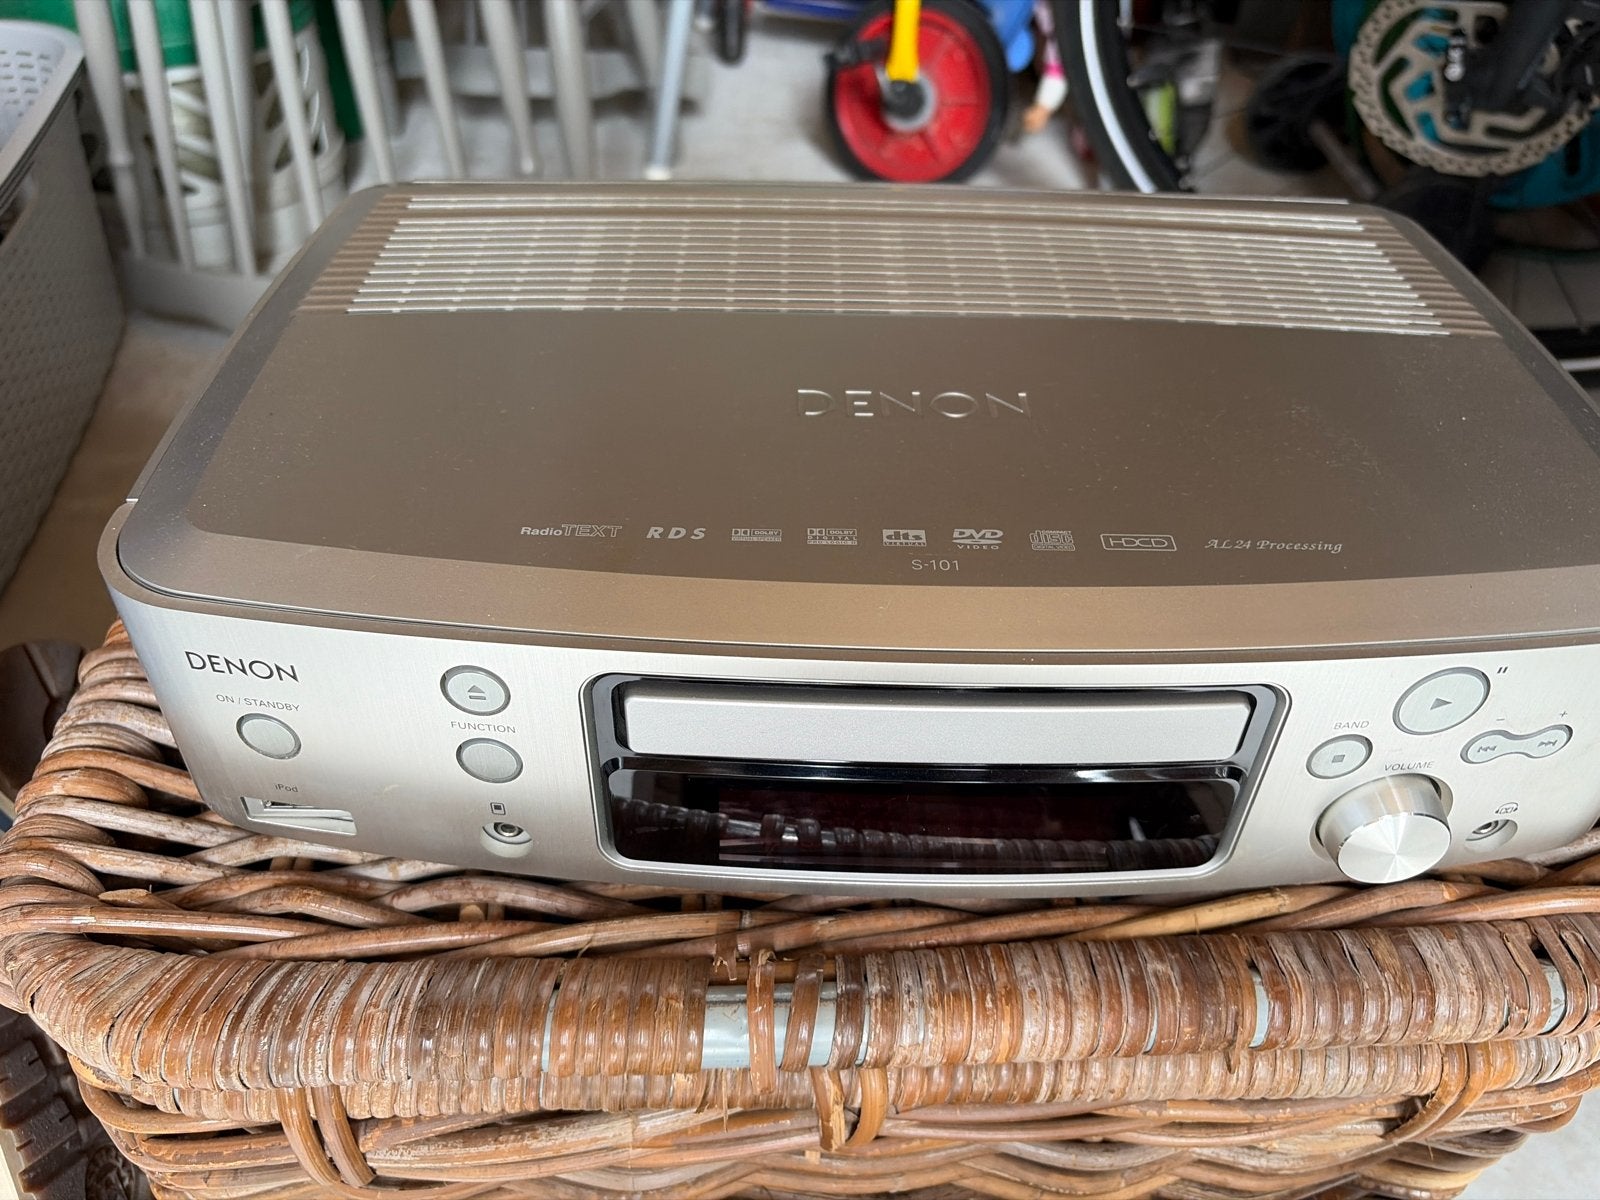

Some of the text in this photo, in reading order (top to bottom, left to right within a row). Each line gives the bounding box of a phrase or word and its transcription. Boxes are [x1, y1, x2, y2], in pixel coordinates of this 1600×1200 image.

[797, 389, 1031, 418] DENON
[646, 526, 707, 540] RDS
[953, 528, 1004, 540] DVD
[1109, 537, 1169, 548] HDCD
[1256, 539, 1343, 554] Processing
[911, 559, 960, 571] S-101
[184, 650, 299, 683] DENON
[216, 694, 235, 704] ON
[244, 697, 300, 712] STANDBY
[450, 720, 516, 734] FUNCTION
[1333, 720, 1370, 730] BAND
[1383, 761, 1434, 772] VOLUME
[274, 783, 298, 793] iPod
